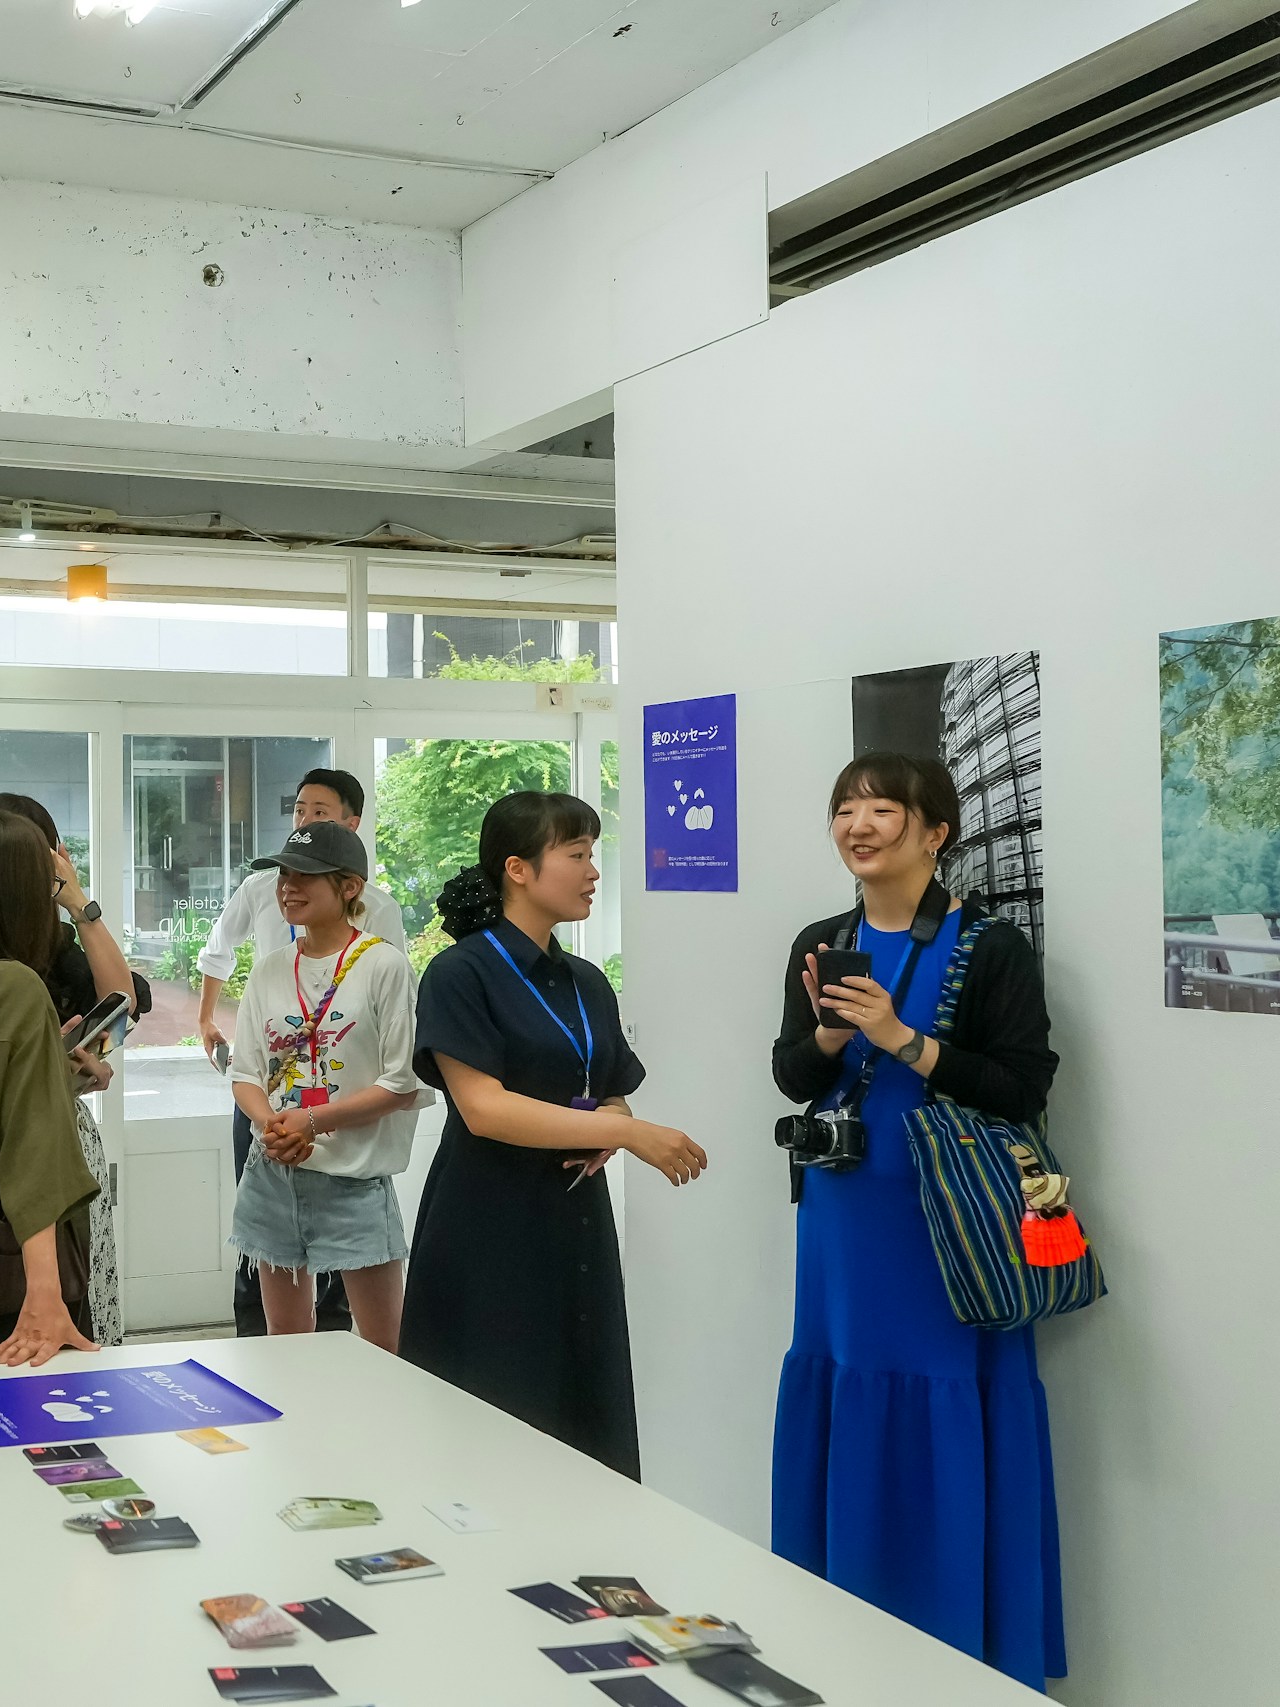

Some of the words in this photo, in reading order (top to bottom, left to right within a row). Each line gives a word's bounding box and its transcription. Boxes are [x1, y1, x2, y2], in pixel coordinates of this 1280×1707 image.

[651, 725, 719, 746] 愛のメッセージ
[141, 1369, 222, 1415] 愛のメッセージ
